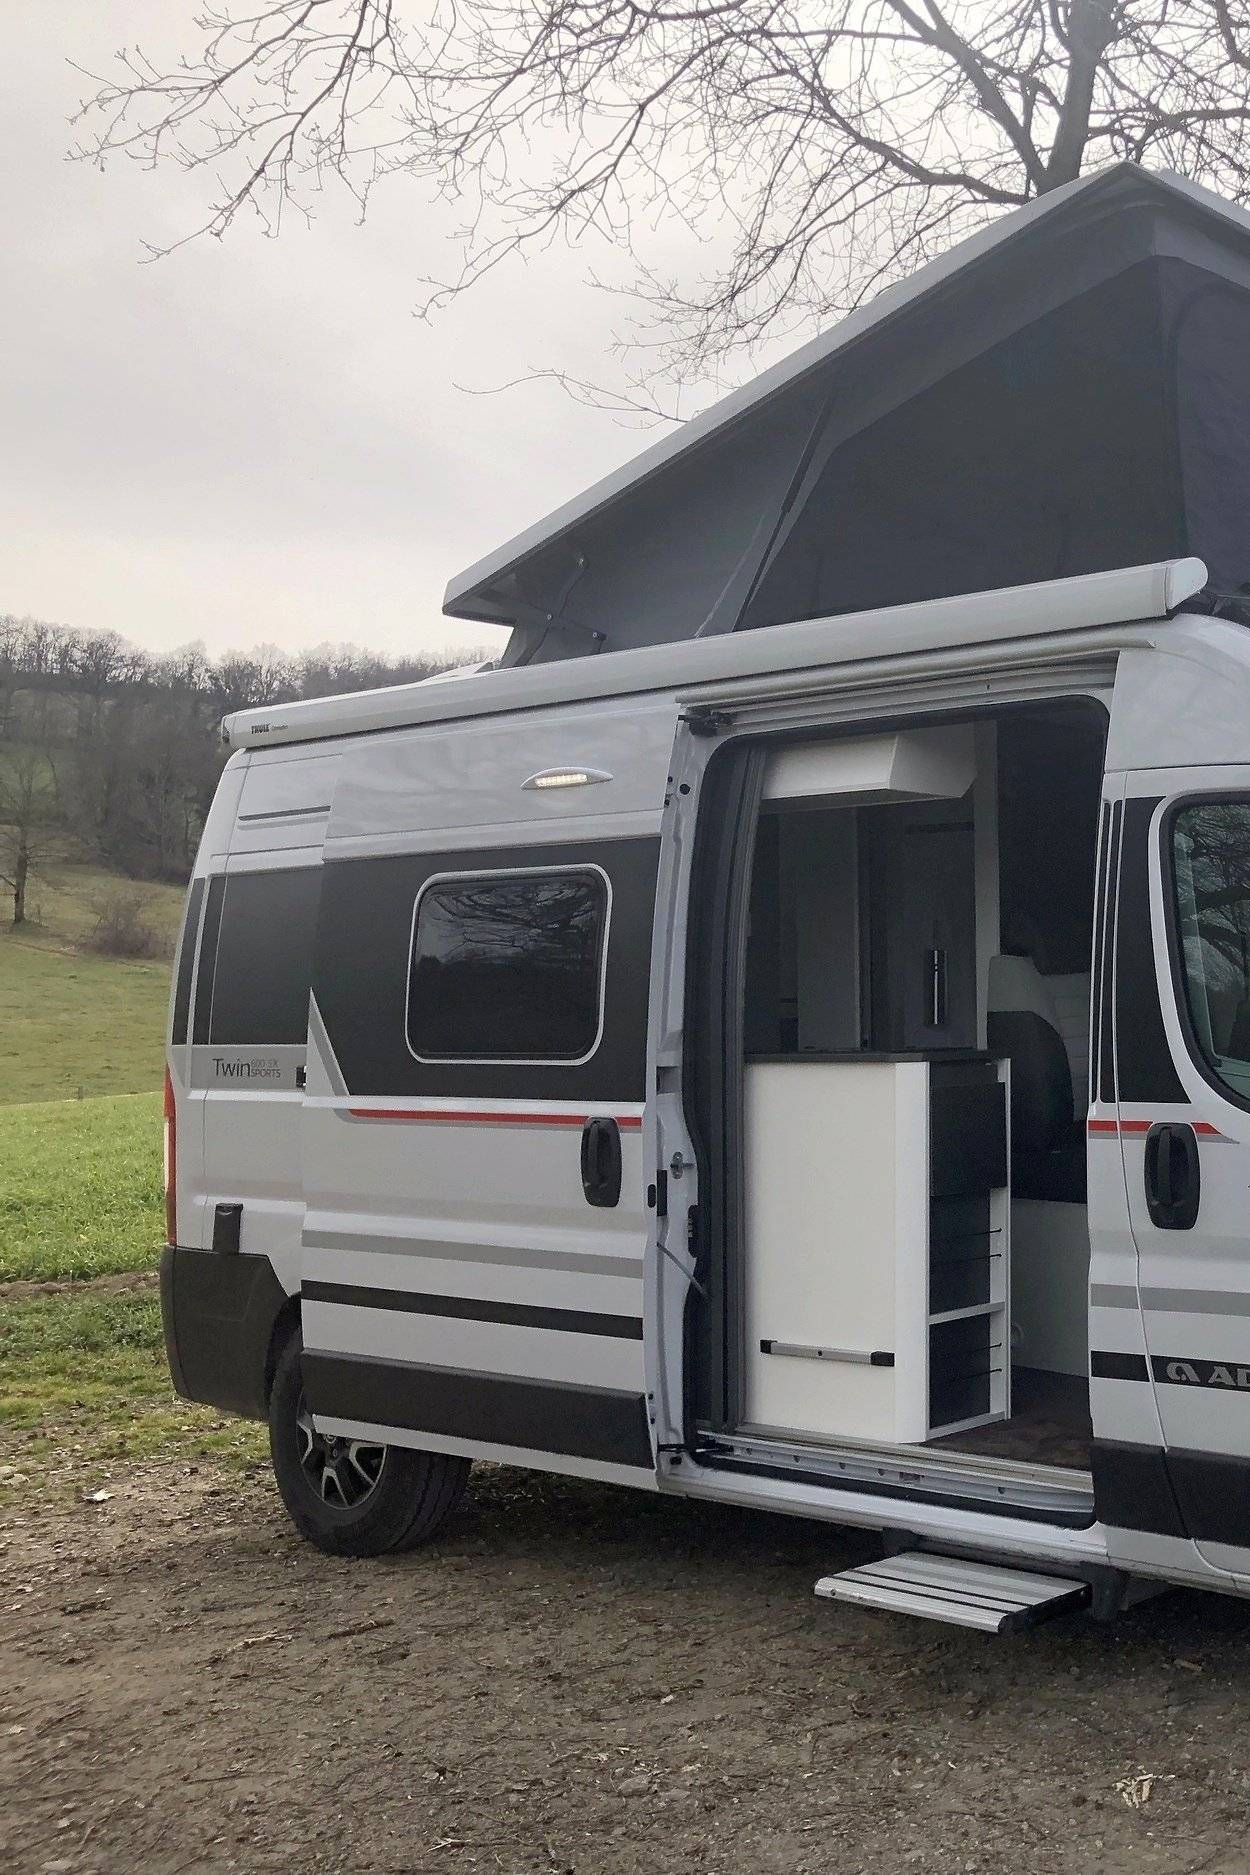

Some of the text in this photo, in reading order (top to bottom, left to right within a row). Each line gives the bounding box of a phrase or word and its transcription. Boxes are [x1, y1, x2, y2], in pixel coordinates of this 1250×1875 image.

[251, 723, 270, 734] THULE
[212, 1058, 251, 1077] Twin
[251, 1069, 281, 1078] SPORTS
